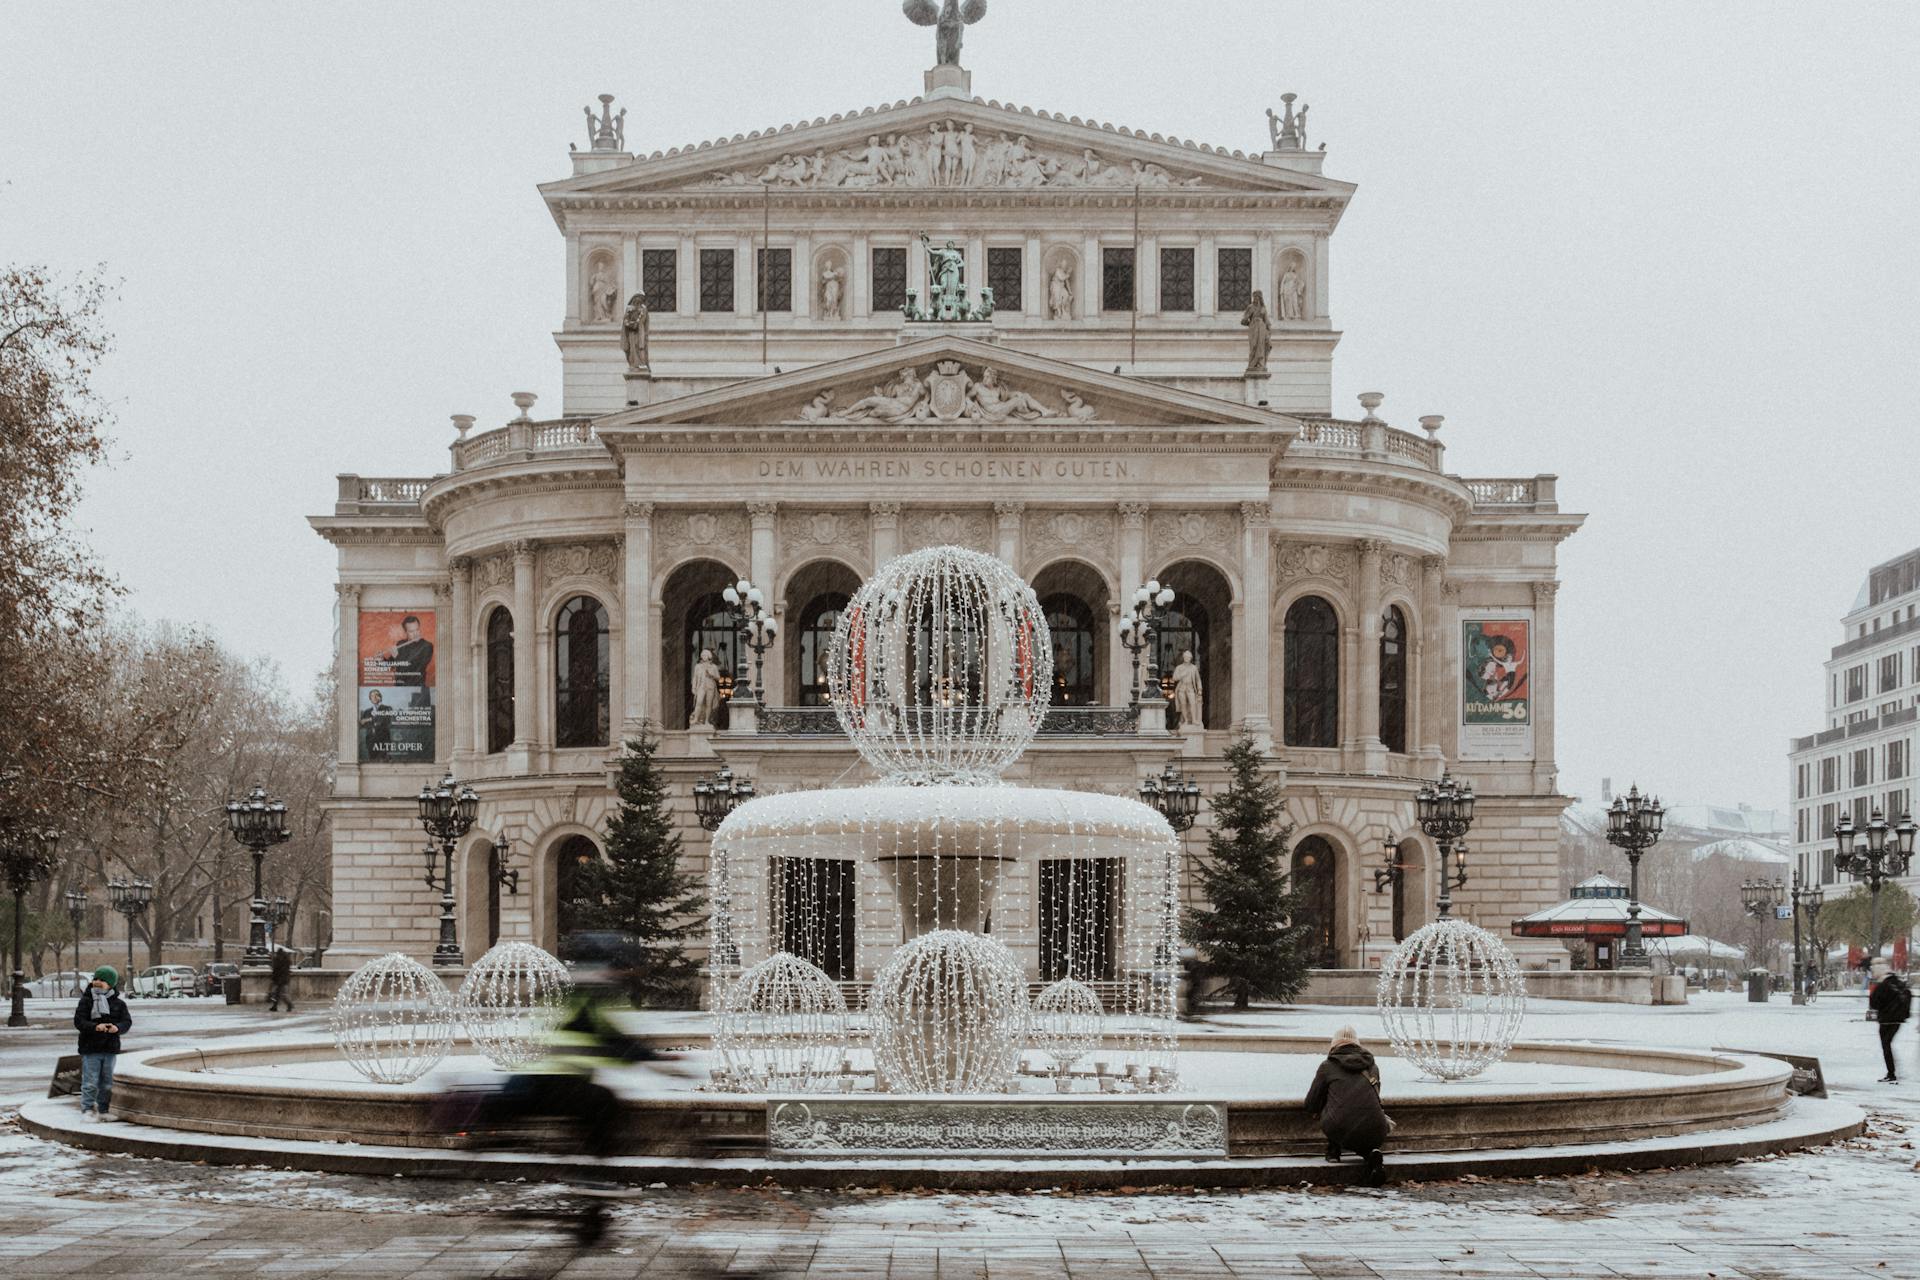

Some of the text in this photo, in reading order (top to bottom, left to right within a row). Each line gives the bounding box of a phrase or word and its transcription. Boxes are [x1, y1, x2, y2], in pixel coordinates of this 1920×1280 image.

[759, 460, 1136, 478] DEM WAHREN SCHOENEN GUTEN.
[1502, 702, 1527, 720] 56
[372, 742, 423, 752] ALTE OPER
[840, 1122, 1154, 1140] Frohe Festtage und ein glückliches neues Jahr
